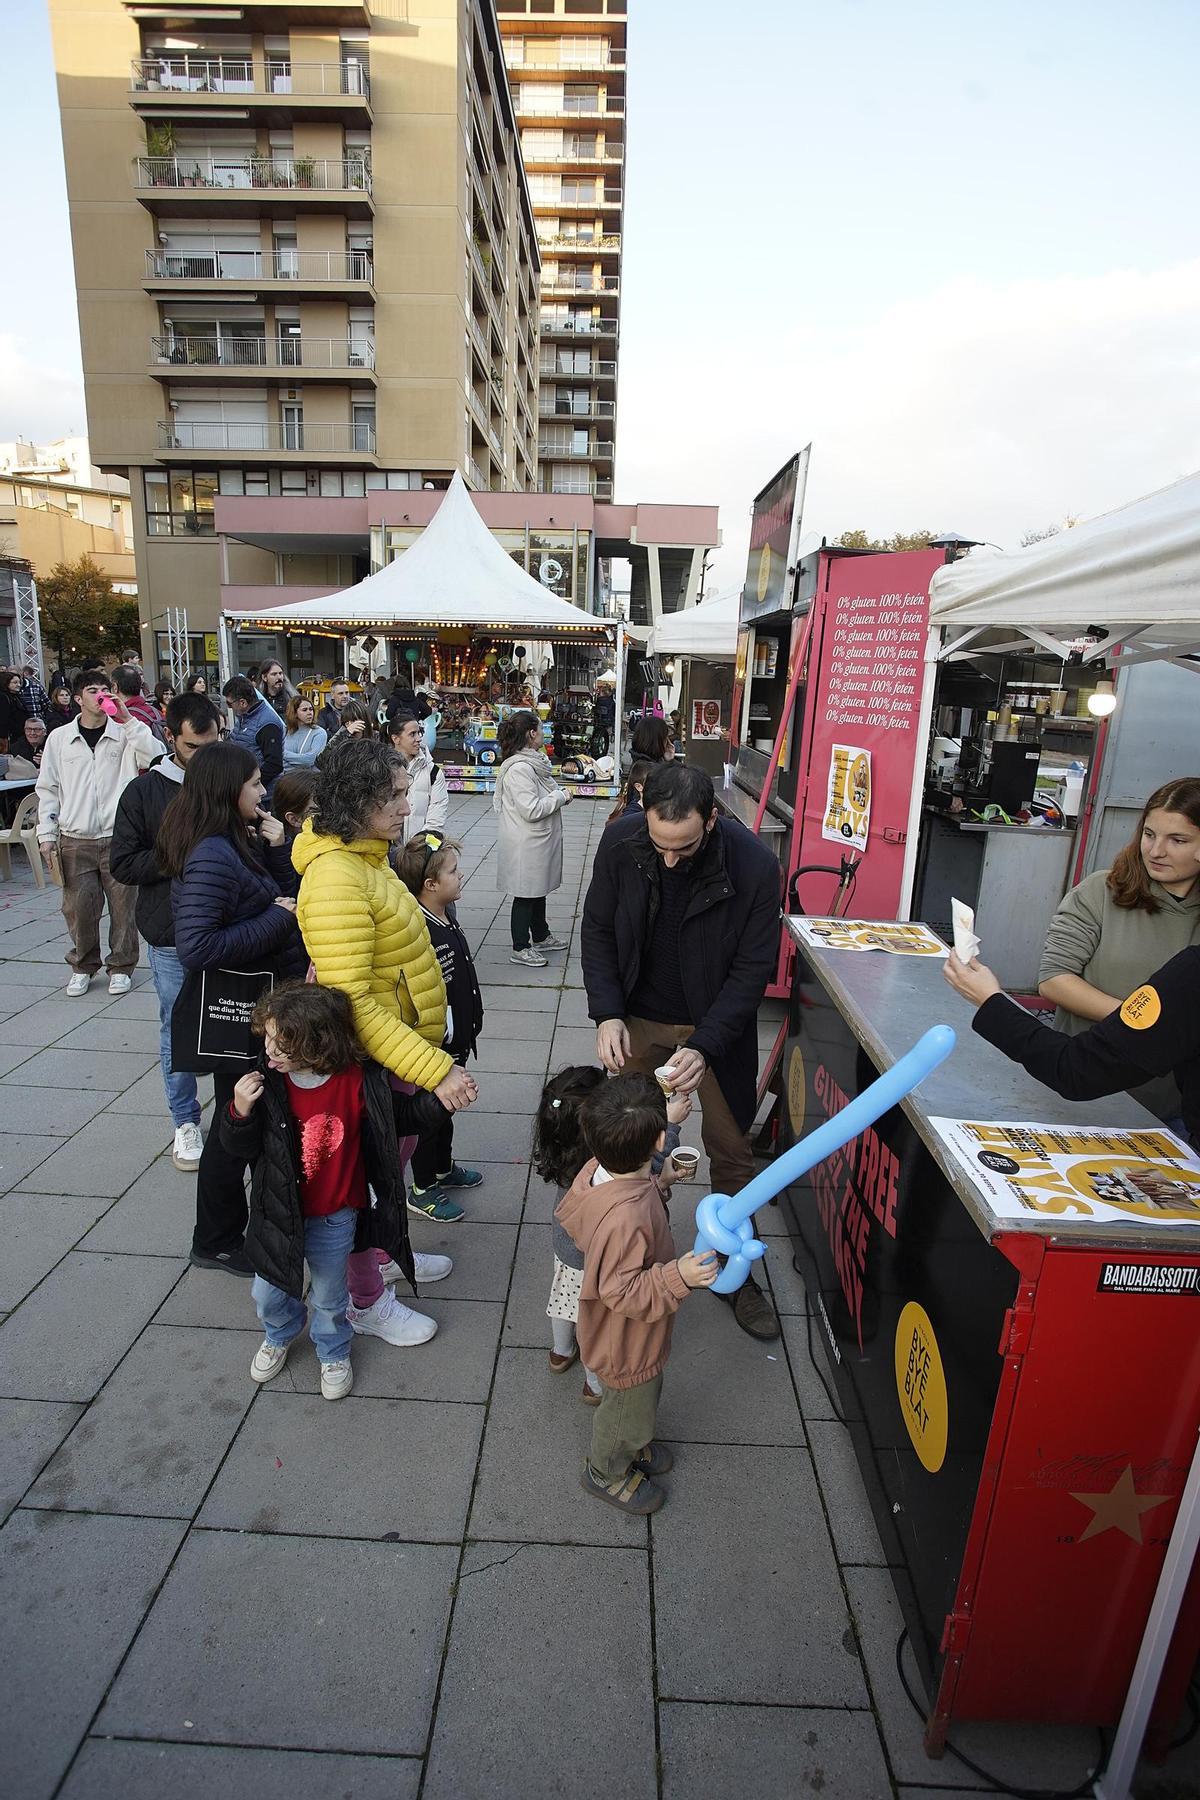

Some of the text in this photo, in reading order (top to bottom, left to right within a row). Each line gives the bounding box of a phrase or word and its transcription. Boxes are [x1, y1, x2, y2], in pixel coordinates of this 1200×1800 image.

[838, 593, 924, 610] 0% gluten. 100% fetén.
[836, 611, 922, 627] 0% gluten. 100% fetén.
[834, 628, 920, 643] 0% gluten. 100% fetén.
[833, 646, 918, 661] 0% gluten. 100% fetén.
[831, 662, 916, 678] 0% gluten. 100% fetén.
[830, 678, 914, 695] 0% gluten. 100% fetén.
[828, 694, 912, 712] 0% gluten. 100% fetén.
[826, 710, 910, 729] 0% gluten. 100% fetén.
[218, 998, 234, 1006] Cada
[1002, 1128, 1031, 1152] MARIBEL
[857, 1126, 900, 1240] FREE
[840, 1178, 870, 1274] THE
[1103, 1265, 1197, 1288] BANDABASSOTTI
[911, 1327, 931, 1379] BYE
[908, 1350, 928, 1400] BYE
[904, 1371, 929, 1433] BLAT
